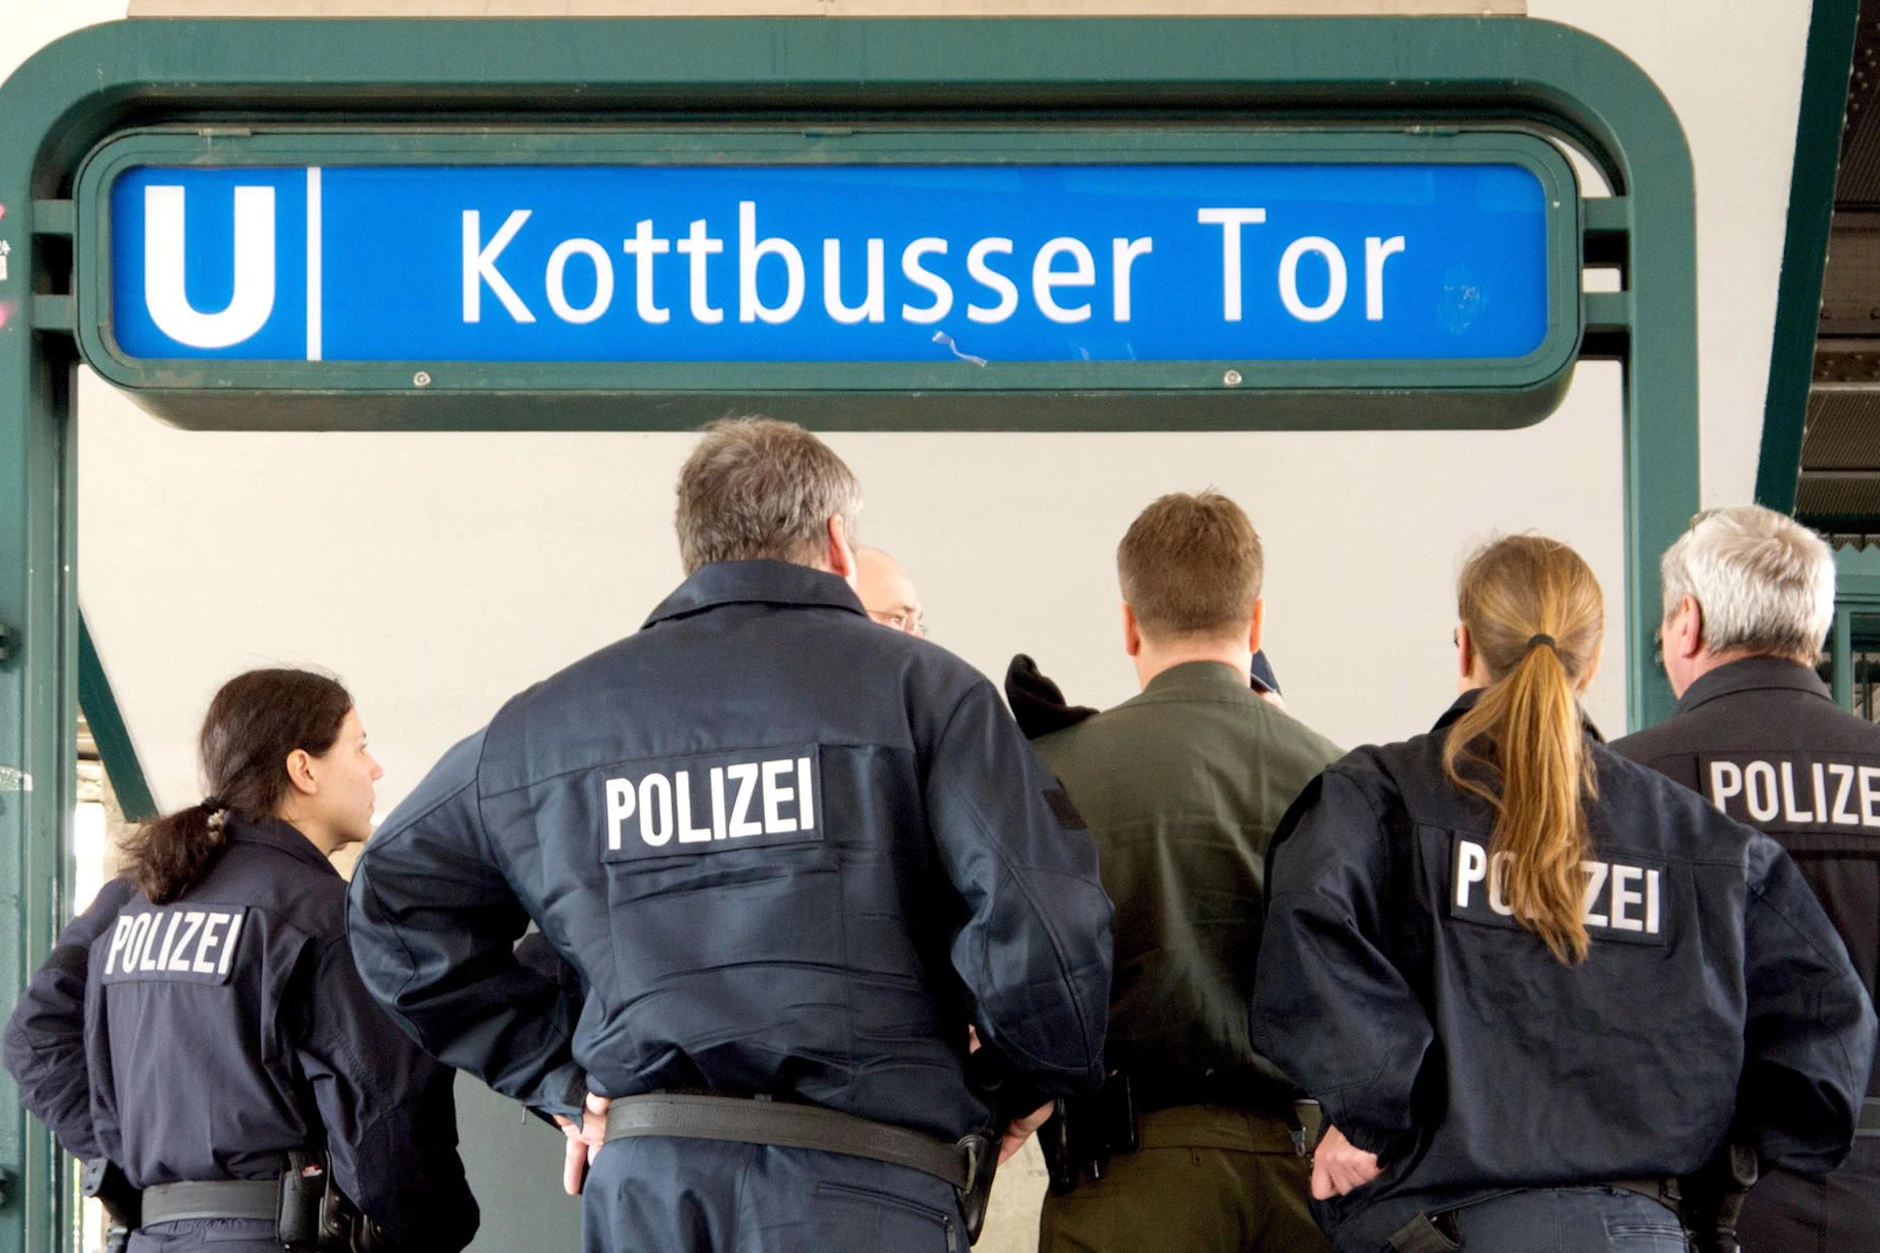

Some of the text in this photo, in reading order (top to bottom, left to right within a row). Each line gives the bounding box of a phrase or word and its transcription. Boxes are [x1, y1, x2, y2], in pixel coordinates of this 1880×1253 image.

[144, 185, 276, 348] U
[461, 200, 1405, 325] Kottbusser Tor
[605, 756, 815, 851] POLIZEI
[1709, 760, 1880, 827] POLIZE
[1456, 839, 1660, 934] POZEI
[104, 911, 242, 976] POLIZEI
